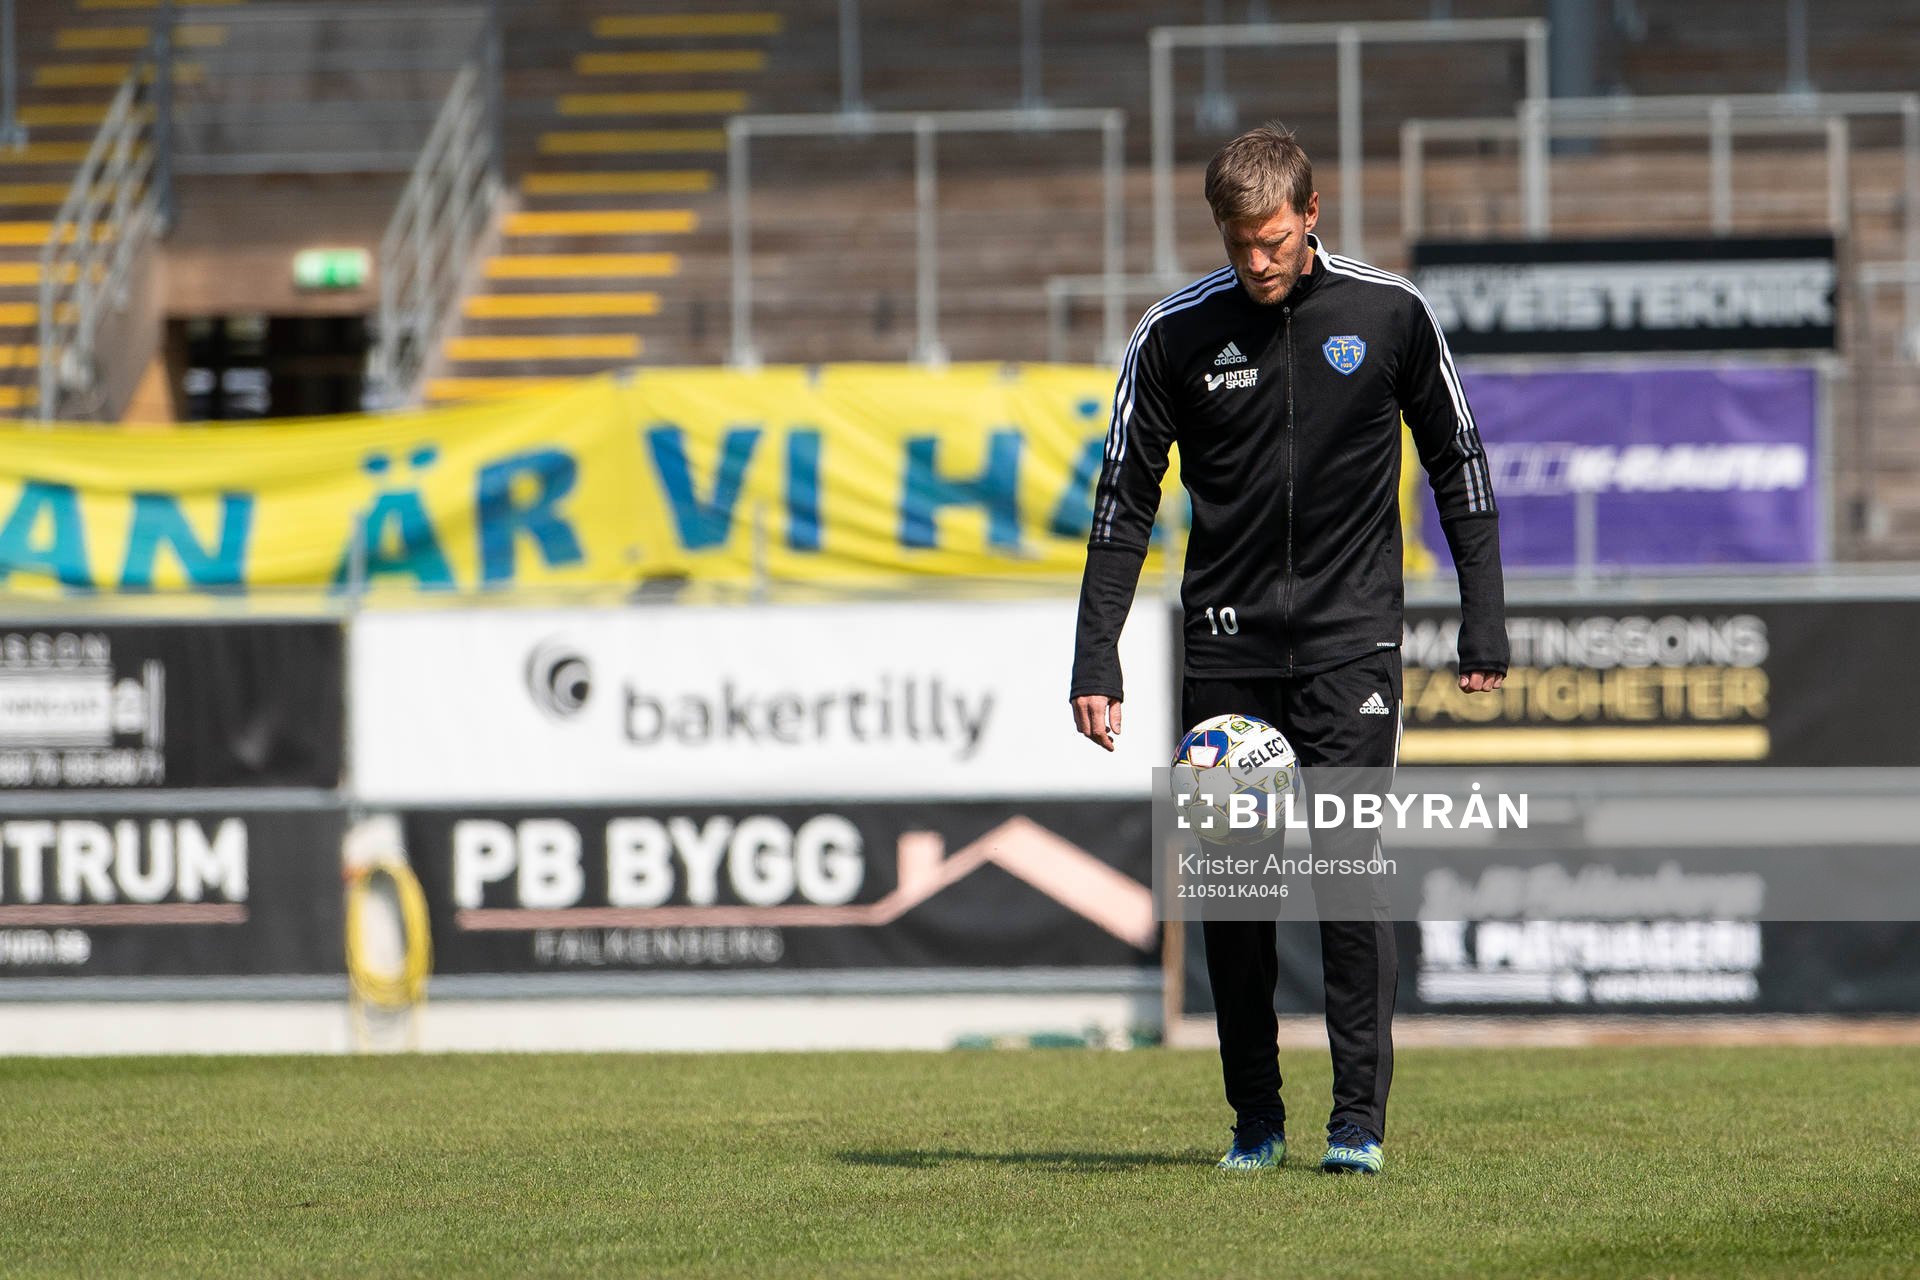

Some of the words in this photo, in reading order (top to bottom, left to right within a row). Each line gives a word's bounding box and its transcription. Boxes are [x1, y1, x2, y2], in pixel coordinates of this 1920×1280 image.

[1214, 355, 1248, 366] adidas
[1225, 369, 1258, 380] INTER
[1225, 378, 1258, 389] SPORT
[332, 447, 584, 594] ÄR
[645, 425, 821, 551] VI
[1205, 607, 1239, 635] 10
[623, 676, 994, 758] bakertilly
[1359, 704, 1390, 715] adidas
[1238, 737, 1289, 775] SELECT
[0, 817, 249, 904] TRUM
[452, 818, 585, 910] PB
[605, 814, 866, 907] BYGG
